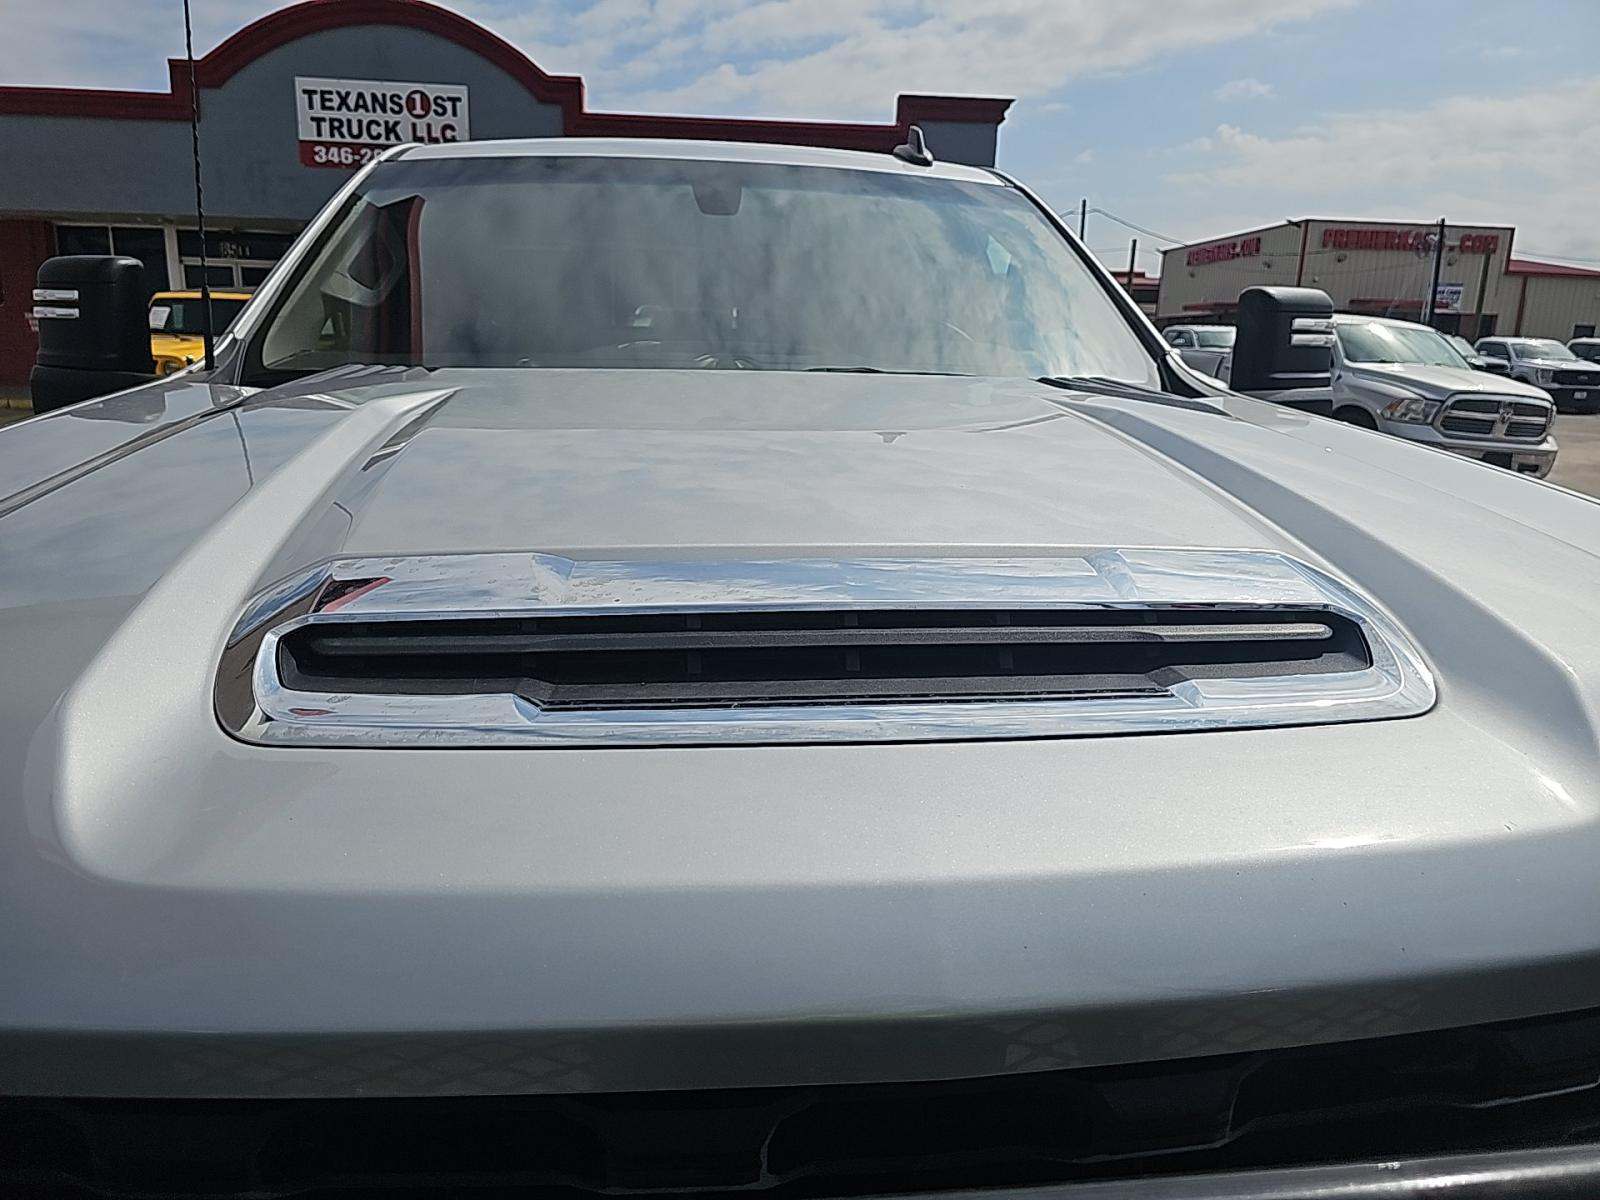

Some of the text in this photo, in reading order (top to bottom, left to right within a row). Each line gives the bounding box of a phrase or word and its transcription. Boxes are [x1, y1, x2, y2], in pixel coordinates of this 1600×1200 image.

[302, 88, 403, 115] TEXANS
[310, 116, 457, 144] TRUCK LLC
